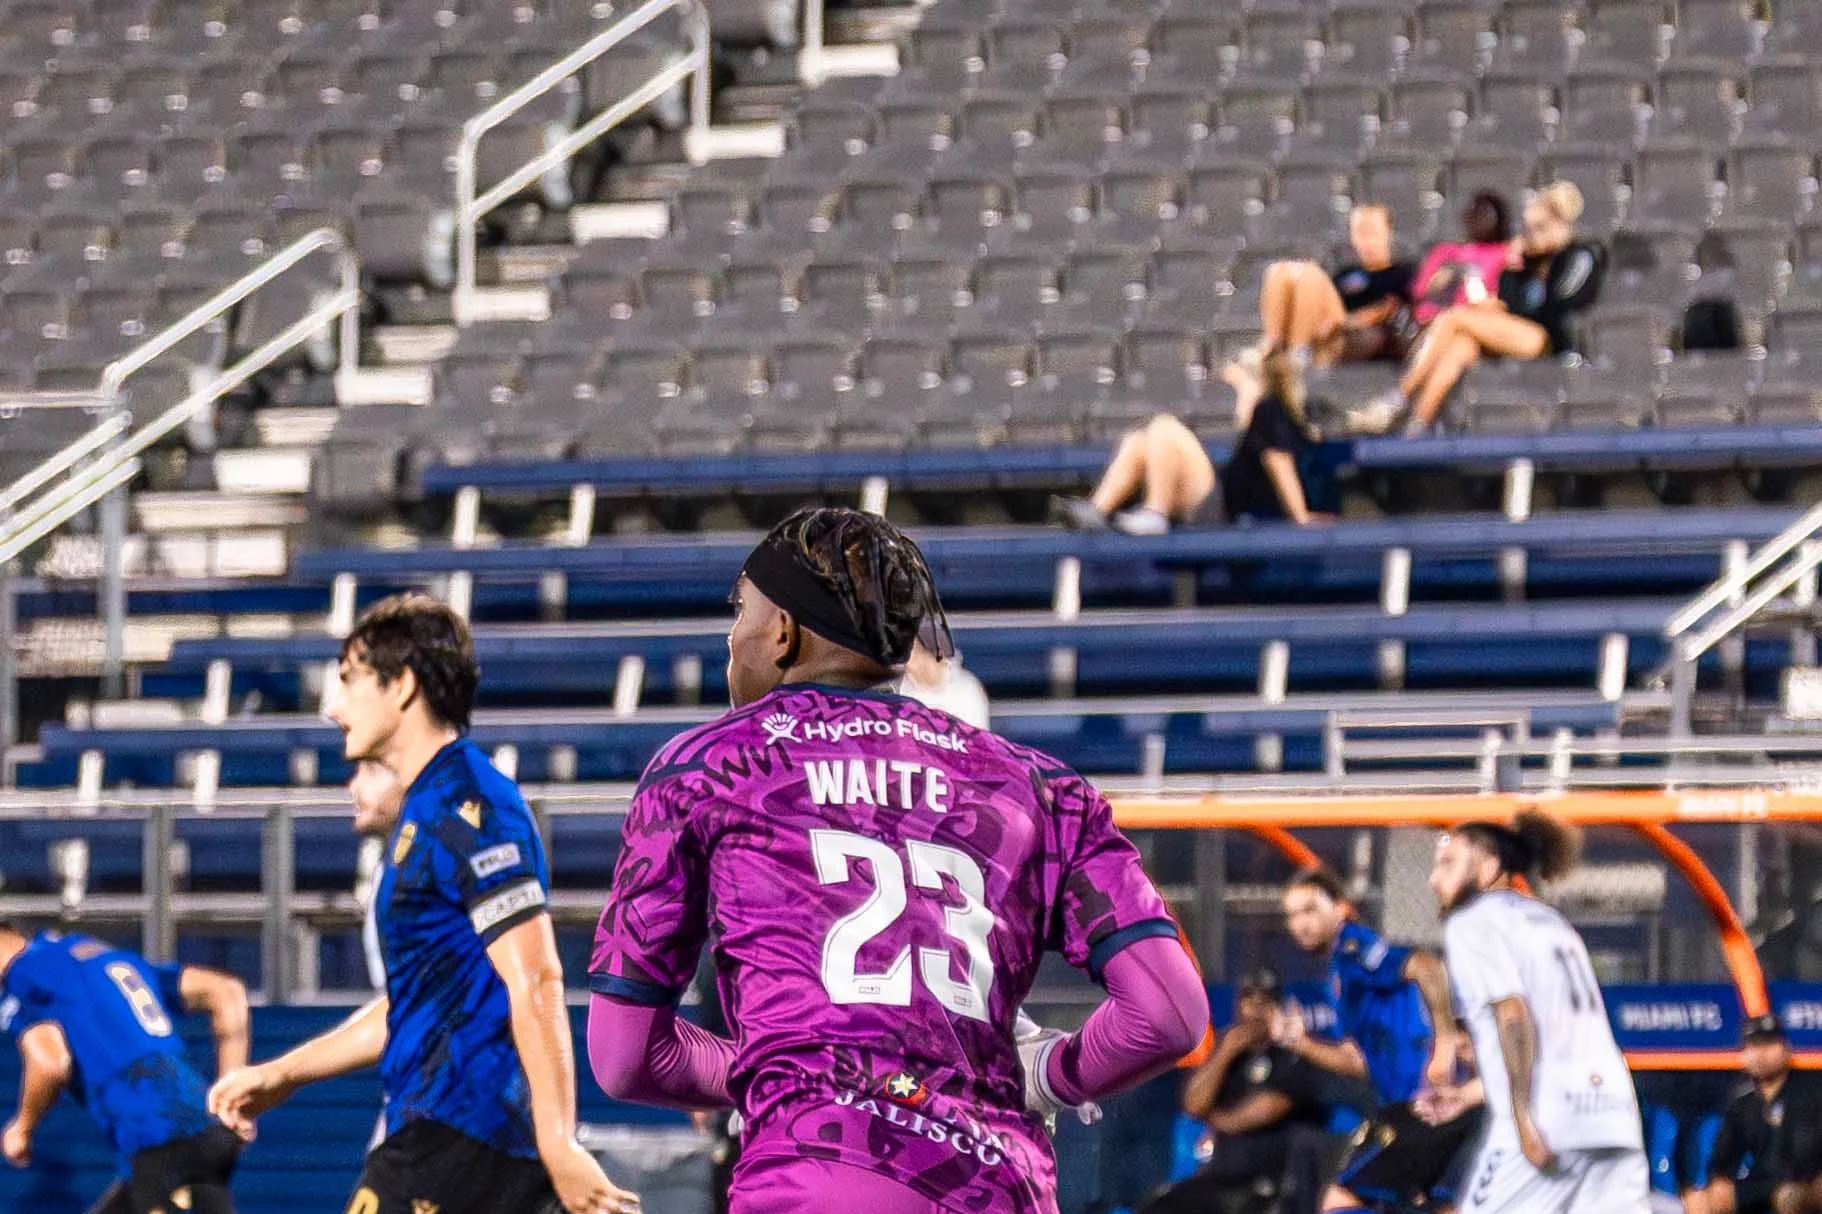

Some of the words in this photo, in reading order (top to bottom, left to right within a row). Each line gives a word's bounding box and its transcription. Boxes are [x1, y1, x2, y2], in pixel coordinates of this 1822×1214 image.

[803, 717, 892, 744] Hydro
[897, 717, 969, 755] Flask
[804, 758, 948, 814] WAITE
[809, 828, 995, 1025] 23
[834, 1090, 1001, 1167] JALISCO
